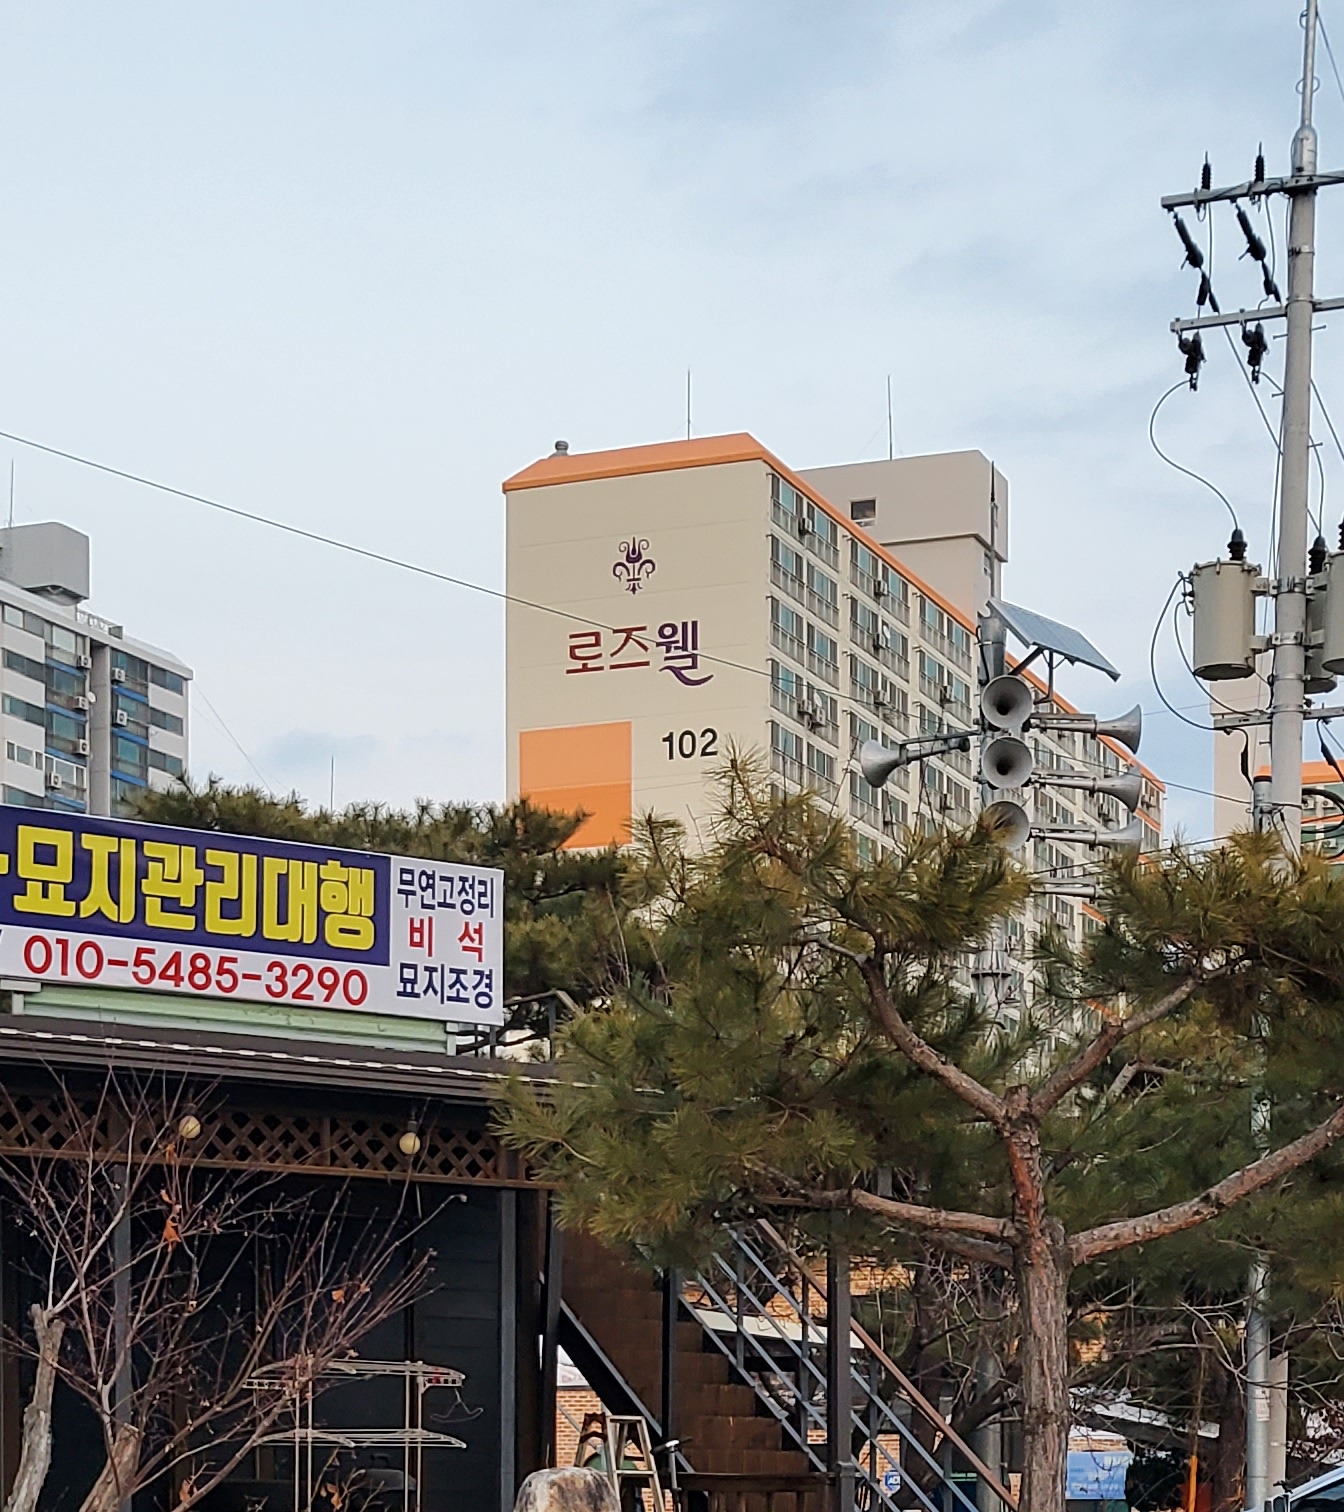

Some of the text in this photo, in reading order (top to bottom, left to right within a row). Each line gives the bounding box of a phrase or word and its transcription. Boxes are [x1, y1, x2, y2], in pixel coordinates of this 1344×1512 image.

[566, 620, 714, 686] 로즈웰
[662, 728, 719, 760] 102
[397, 867, 494, 918] 무연고정리
[24, 935, 368, 1006] 010-5485-3290
[396, 962, 493, 1009] 묘지조경
